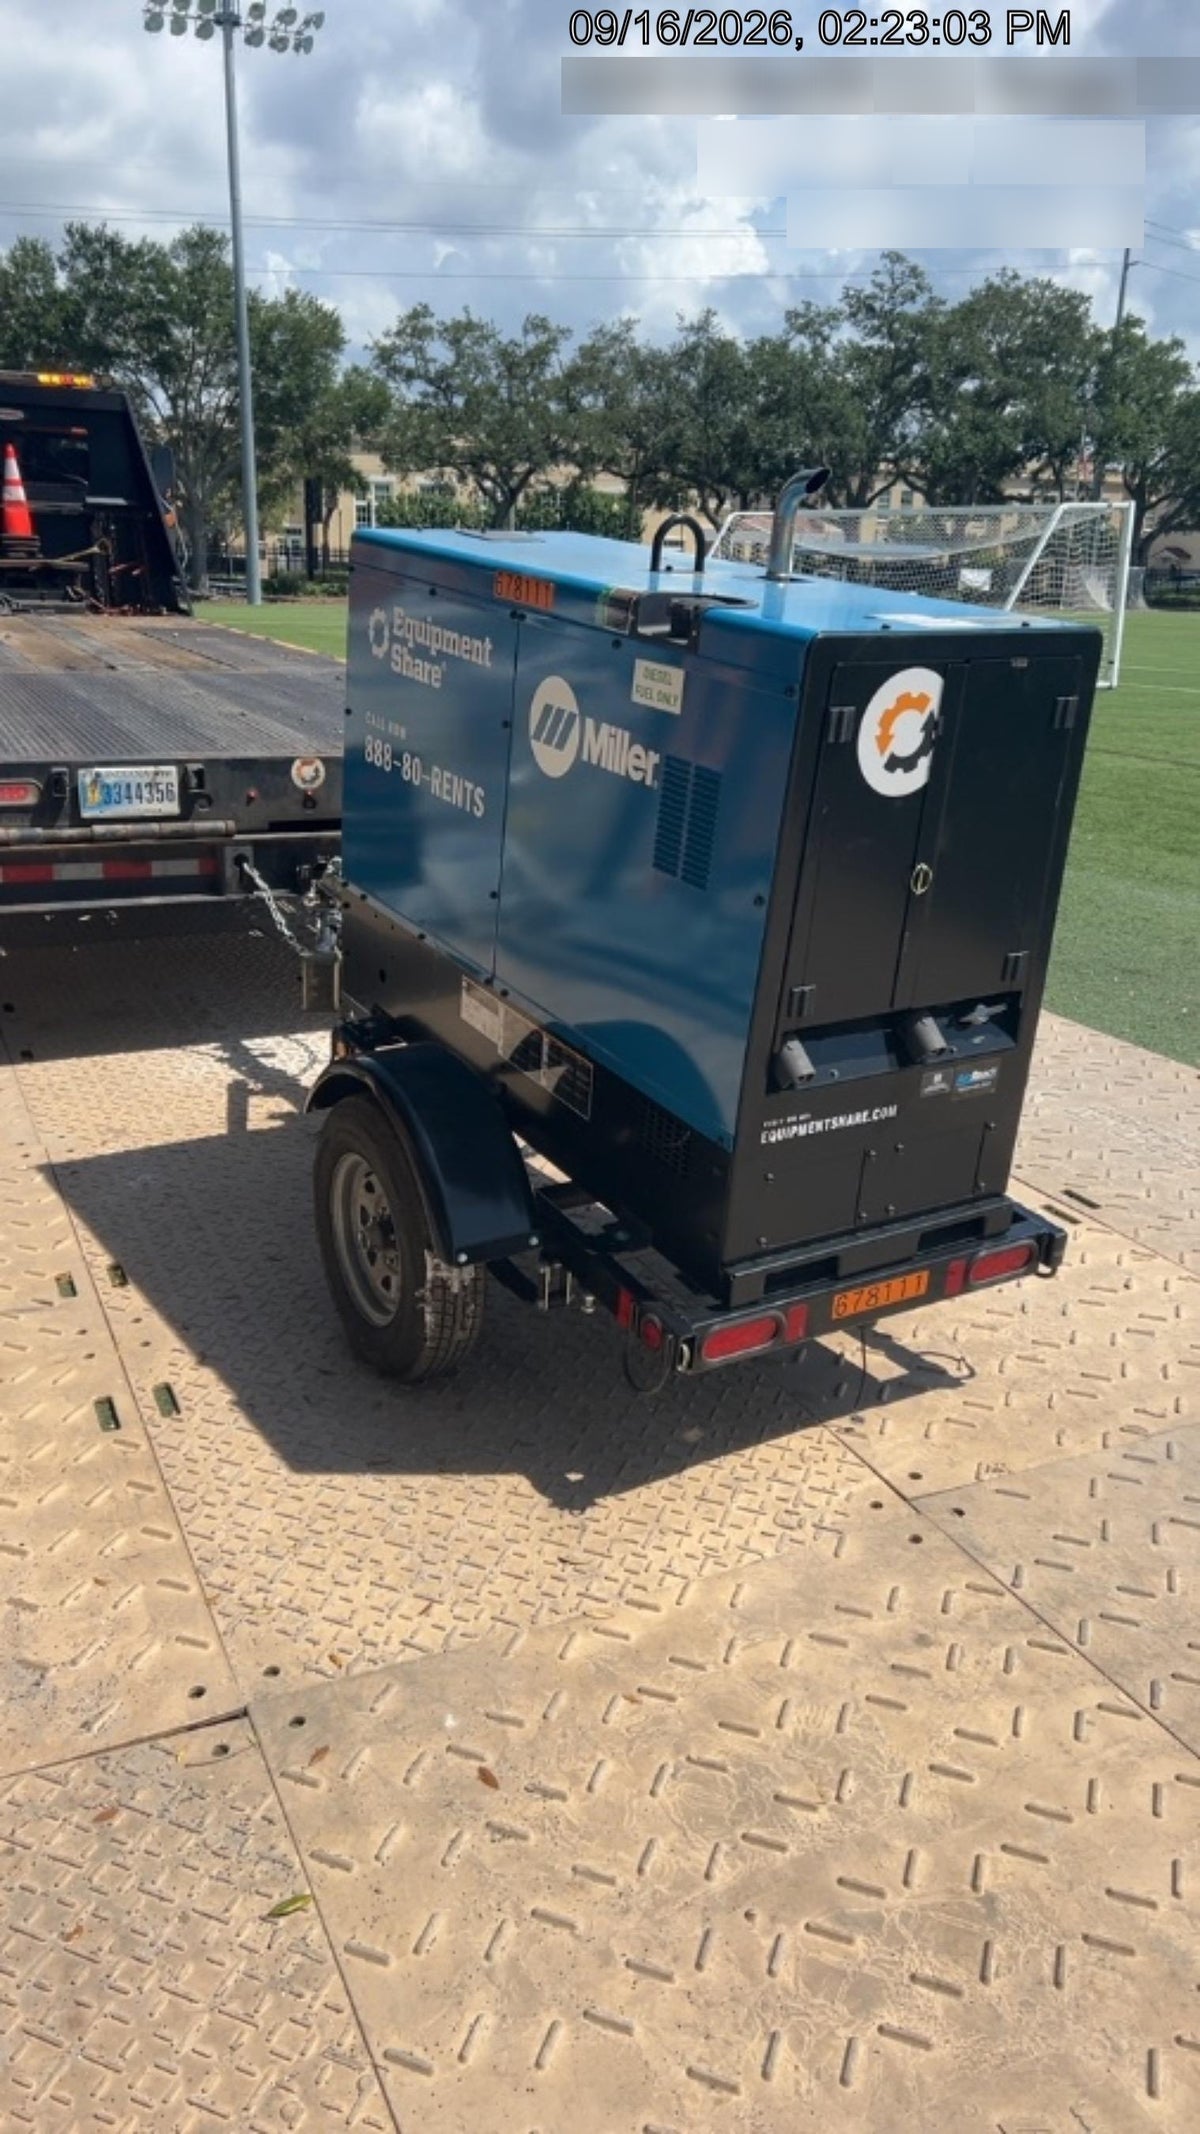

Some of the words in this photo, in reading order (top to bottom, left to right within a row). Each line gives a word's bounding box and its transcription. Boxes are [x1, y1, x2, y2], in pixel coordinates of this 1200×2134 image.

[392, 606, 493, 668] Equipment
[390, 643, 443, 689] Share
[641, 666, 673, 687] DIESEL
[635, 683, 655, 701] FUEL
[656, 689, 680, 708] ONLY
[581, 716, 660, 788] Miller
[364, 735, 486, 819] 888-80-RENTS
[760, 1103, 898, 1144] EQUIPMENTSHARE.COM
[835, 1274, 924, 1317] 678111
